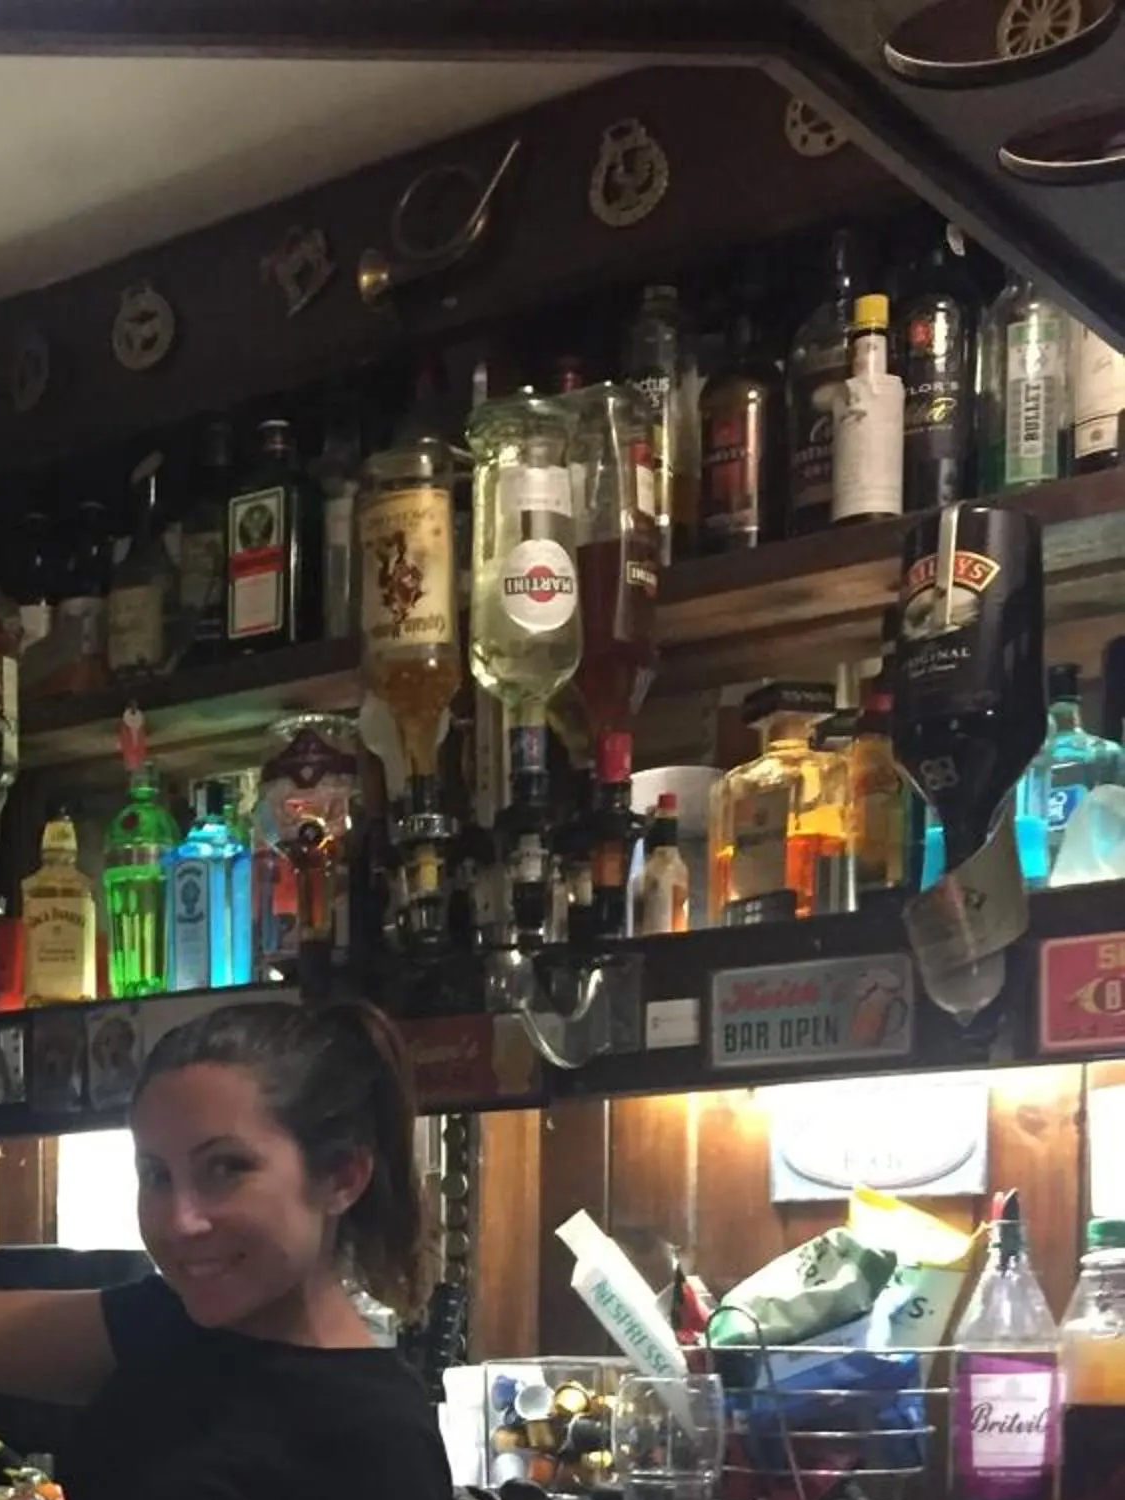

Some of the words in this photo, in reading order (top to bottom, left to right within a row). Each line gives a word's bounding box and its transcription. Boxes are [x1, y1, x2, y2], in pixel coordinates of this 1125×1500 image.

[506, 578, 572, 594] MARTINI
[724, 1021, 770, 1053] BAR
[779, 1013, 839, 1049] OPEN
